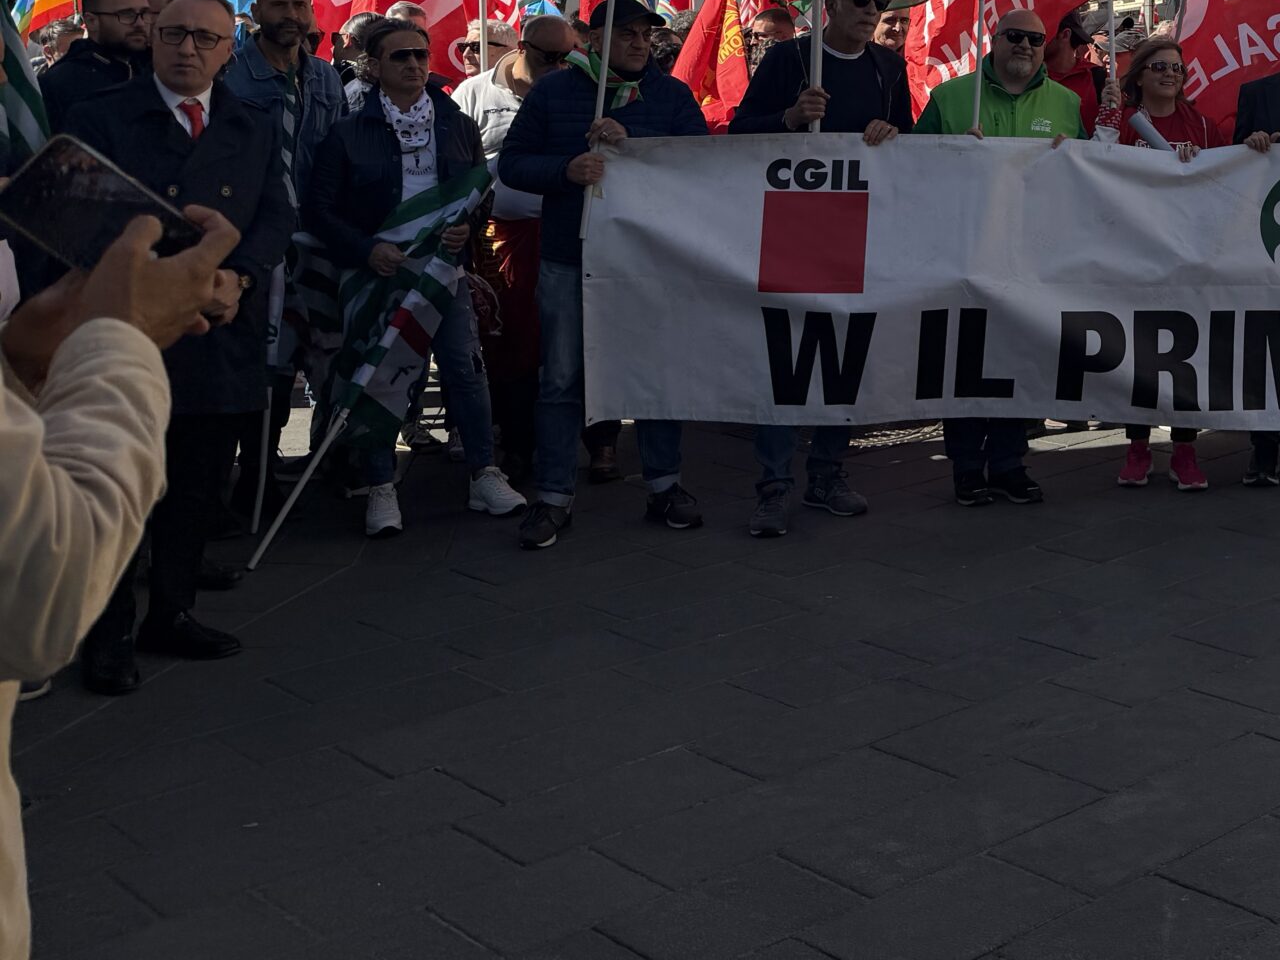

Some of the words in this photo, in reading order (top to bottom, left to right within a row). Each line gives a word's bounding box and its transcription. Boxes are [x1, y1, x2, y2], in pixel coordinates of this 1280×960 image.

[766, 158, 869, 191] CGIL
[760, 306, 878, 406] W
[915, 307, 1015, 401] IL
